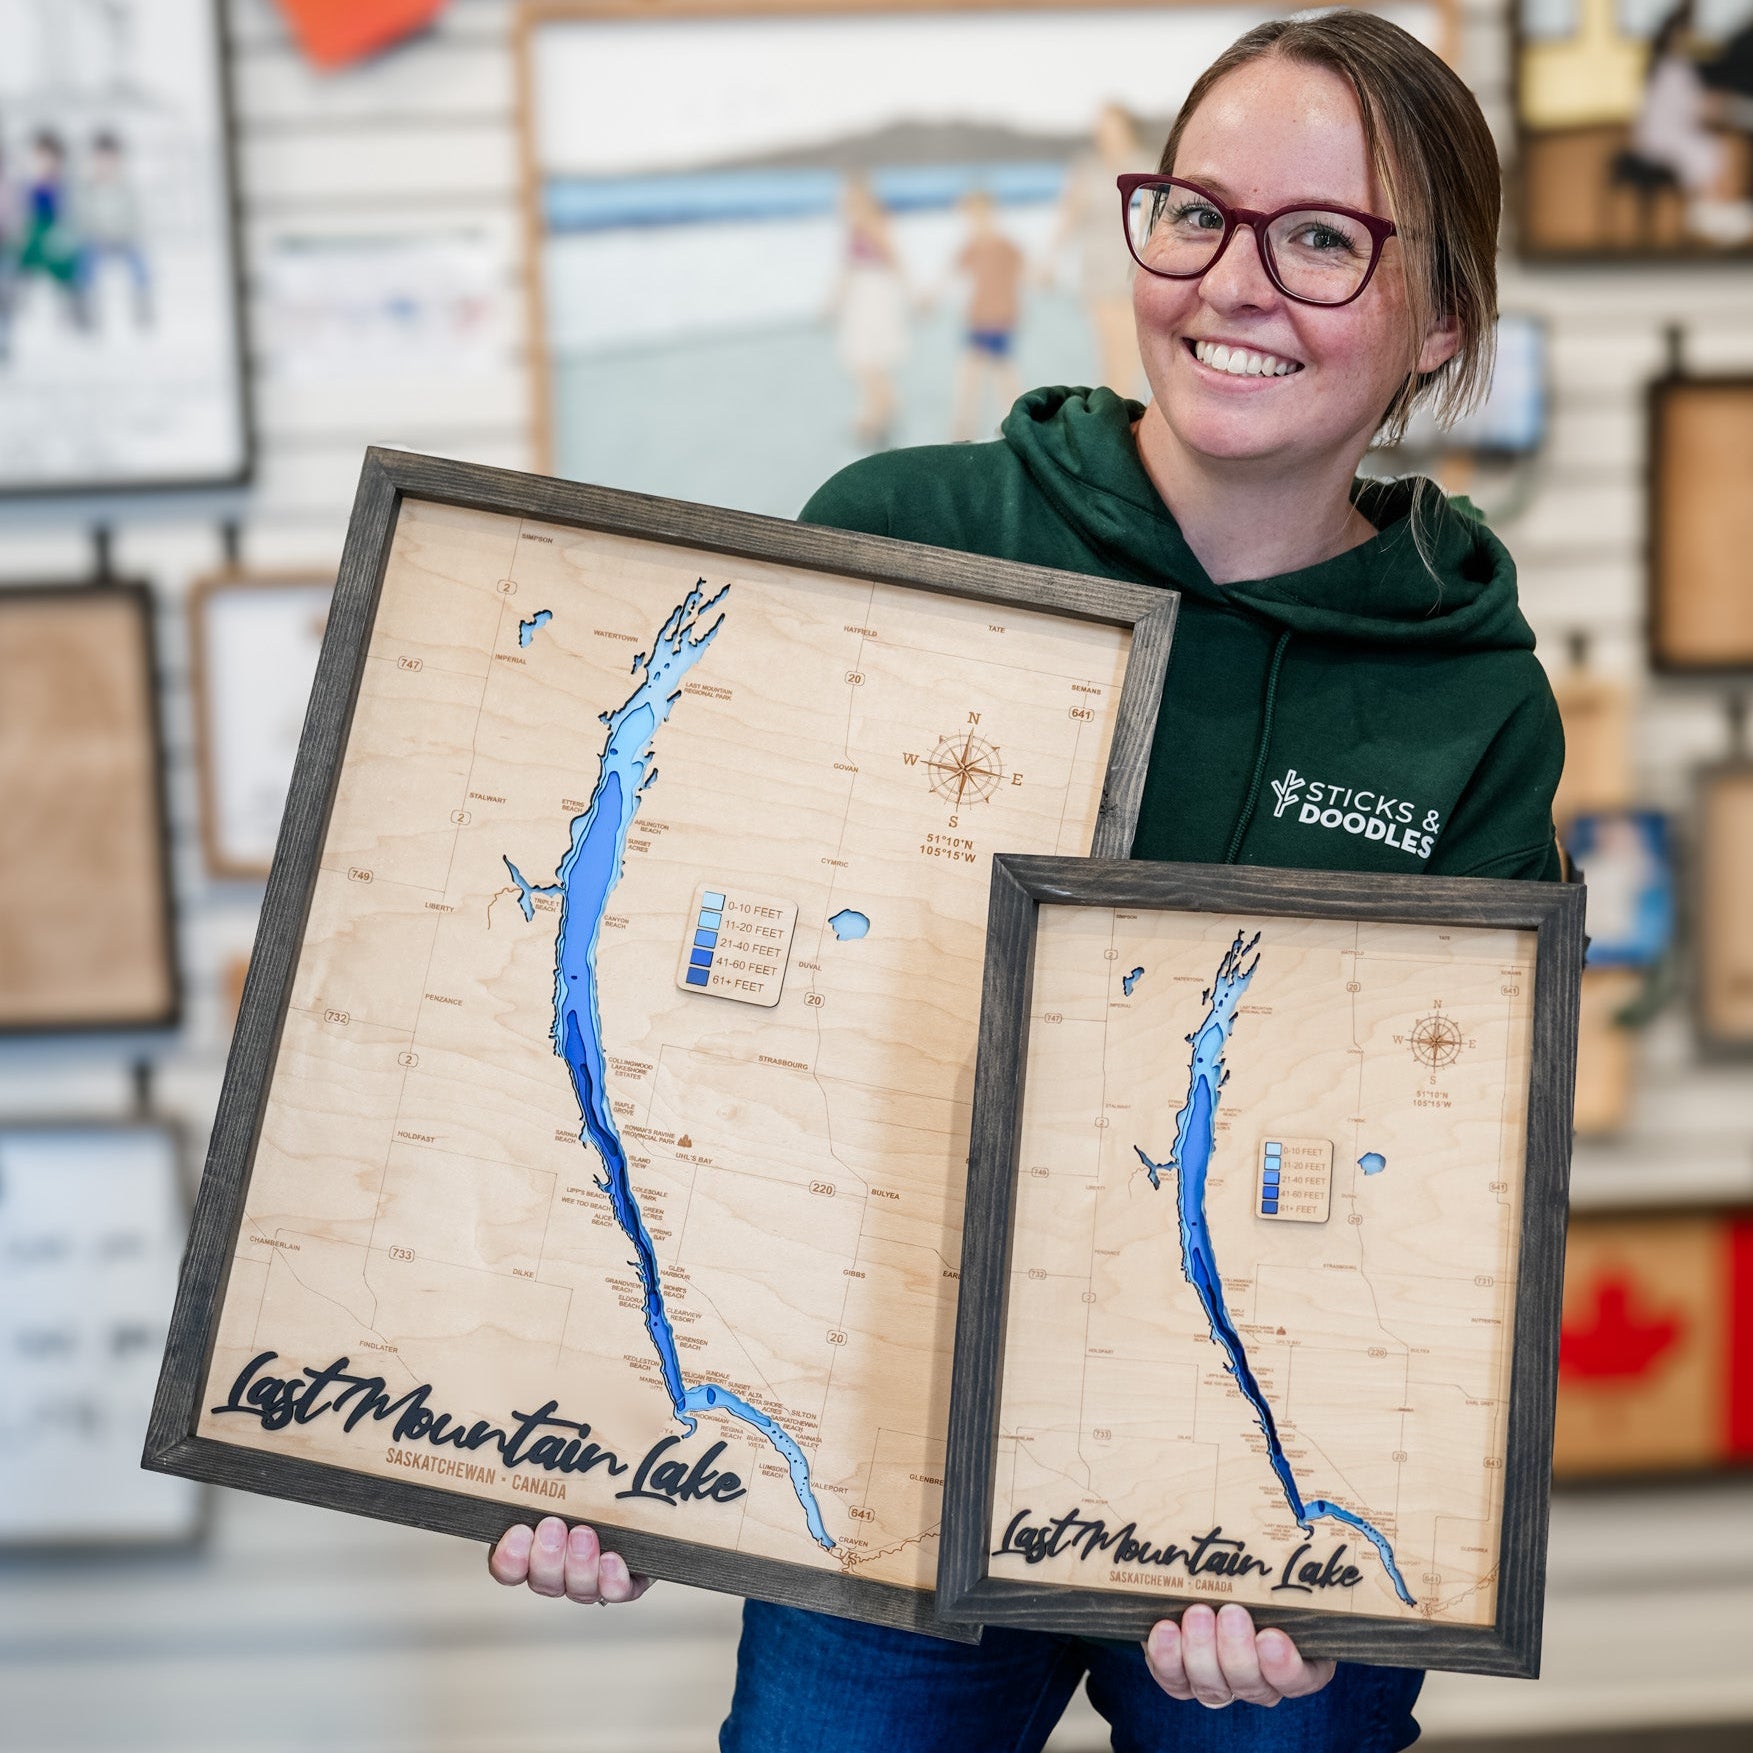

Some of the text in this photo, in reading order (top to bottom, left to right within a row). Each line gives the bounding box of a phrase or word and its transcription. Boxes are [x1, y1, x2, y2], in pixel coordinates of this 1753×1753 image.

[521, 533, 553, 544] SIMPSON
[503, 583, 511, 592] 2
[844, 625, 878, 637] HATFIELD
[988, 625, 1006, 633] TATE
[593, 629, 639, 642] WATERTOWN
[495, 654, 527, 664] IMPERIAL
[401, 659, 420, 670] 747
[848, 674, 862, 684] 20
[685, 682, 732, 696] LAST MOUNTAIN
[1071, 684, 1101, 694] SEMANS
[684, 688, 732, 702] REGIONAL PARK
[967, 712, 982, 724] N
[1072, 708, 1092, 720] 641
[902, 752, 920, 766] W
[833, 763, 859, 774] GOVAN
[1011, 774, 1024, 786] E
[470, 792, 507, 804] STALWART
[562, 798, 585, 808] ETTERS
[562, 805, 582, 813] BEACH
[1306, 782, 1440, 834] STICKS &
[457, 814, 465, 822] 2
[948, 816, 958, 828] S
[634, 820, 670, 831] ARLINGTON
[1298, 802, 1436, 858] DOODLES
[640, 827, 662, 835] BEACH
[628, 838, 652, 848] SUNSET
[628, 845, 648, 853] ACRES
[820, 857, 849, 868] CYMRIC
[352, 870, 370, 881] 749
[424, 902, 455, 912] LIBERTY
[535, 904, 557, 912] BEACH
[728, 901, 784, 920] 0-10 FEET
[604, 914, 630, 924] CANYON
[604, 921, 626, 929] BEACH
[726, 920, 785, 939] 11-20 FEET
[720, 938, 782, 958] 21-40 FEET
[716, 956, 778, 976] 41-60 FEET
[798, 961, 822, 972] DUVAL
[712, 975, 764, 992] 61+ FEET
[1349, 984, 1358, 992] 20
[425, 994, 464, 1006] PENZANCE
[808, 994, 822, 1006] 20
[1432, 1000, 1442, 1008] N
[328, 1012, 347, 1023] 732
[1046, 1014, 1060, 1022] 747
[1392, 1035, 1404, 1044] W
[1468, 1040, 1476, 1048] E
[404, 1055, 412, 1064] 2
[758, 1055, 809, 1070] STRASBOURG
[1430, 1076, 1436, 1084] S
[397, 1130, 435, 1142] HOLDFAST
[554, 1136, 576, 1144] BEACH
[698, 1156, 712, 1164] BAY
[1305, 1163, 1326, 1171] FEET
[1305, 1177, 1326, 1185] FEET
[812, 1182, 833, 1194] 220
[586, 1190, 608, 1200] BEACH
[871, 1188, 900, 1200] BULYEA
[1304, 1192, 1325, 1200] FEET
[590, 1202, 612, 1212] BEACH
[1296, 1206, 1318, 1214] FEET
[592, 1219, 613, 1228] BEACH
[249, 1235, 301, 1252] CHAMBERLAIN
[392, 1248, 412, 1260] 733
[512, 1268, 536, 1278] DILKE
[842, 1269, 866, 1278] GIBBS
[612, 1285, 633, 1294] BEACH
[664, 1291, 685, 1300] BEACH
[619, 1301, 640, 1310] BEACH
[830, 1333, 844, 1344] 20
[359, 1340, 398, 1354] FINDLATER
[680, 1342, 701, 1350] BEACH
[630, 1362, 652, 1371] BEACH
[791, 1410, 817, 1420] SILTON
[212, 1351, 747, 1506] Last Mountain Lake
[782, 1424, 804, 1432] BEACH
[720, 1432, 742, 1440] BEACH
[1095, 1430, 1110, 1438] 733
[1396, 1452, 1404, 1460] 20
[386, 1447, 567, 1500] SASKATCHEWAN CANADA
[759, 1463, 788, 1474] LUMSDEN
[762, 1470, 784, 1478] BEACH
[810, 1482, 848, 1494] VALEPORT
[850, 1508, 871, 1520] 641
[838, 1536, 868, 1548] CRAVEN
[992, 1508, 1364, 1593] Last Mountain Lake
[1109, 1570, 1234, 1593] SASKATCHEWAN CANADA
